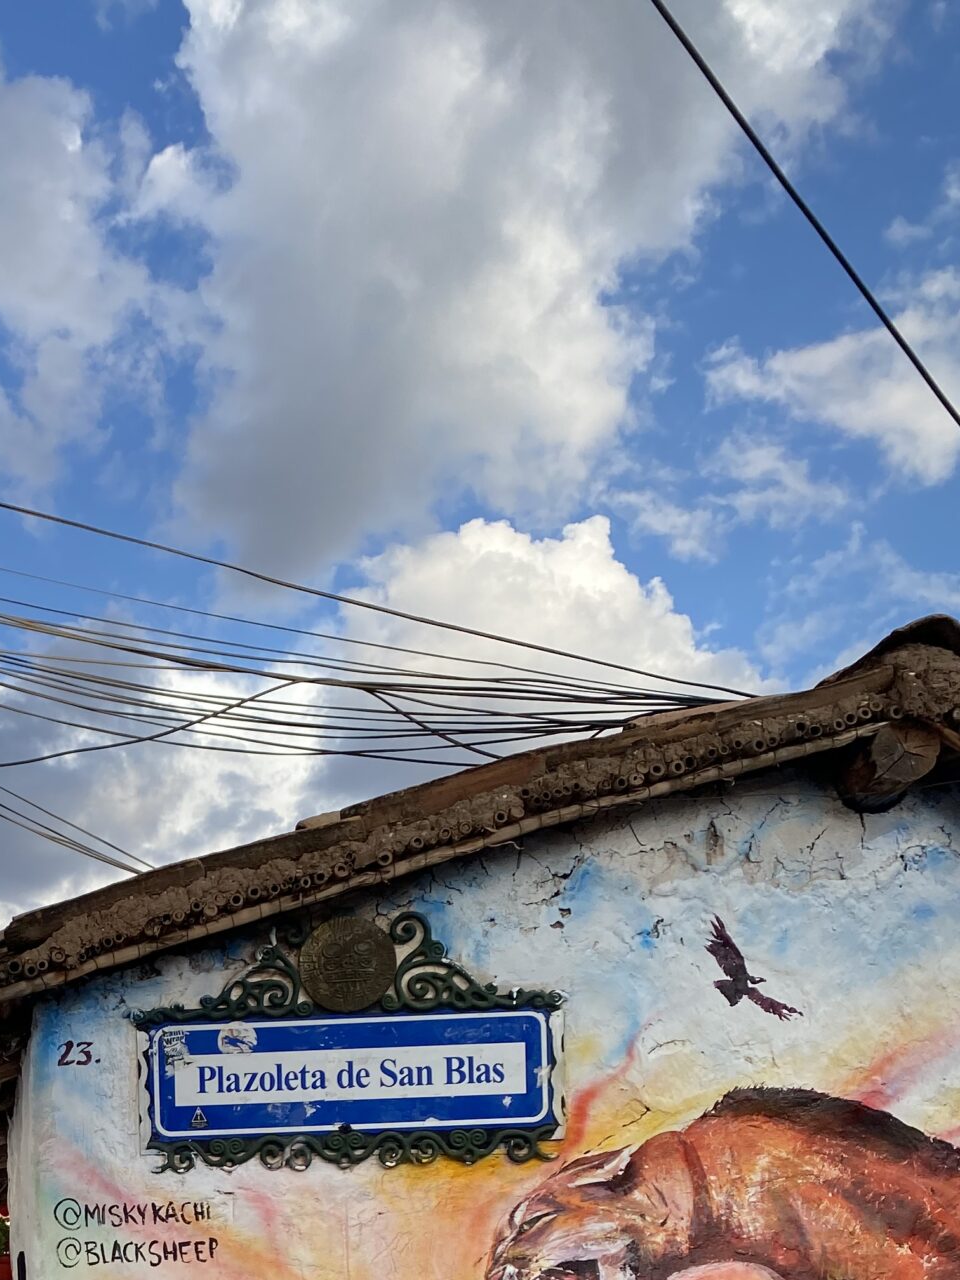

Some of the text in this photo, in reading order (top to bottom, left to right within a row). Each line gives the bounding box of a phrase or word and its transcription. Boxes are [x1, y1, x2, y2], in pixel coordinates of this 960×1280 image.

[197, 1056, 505, 1094] Plazoleta de San Blas
[56, 1236, 219, 1268] @BLACKSHEEP
